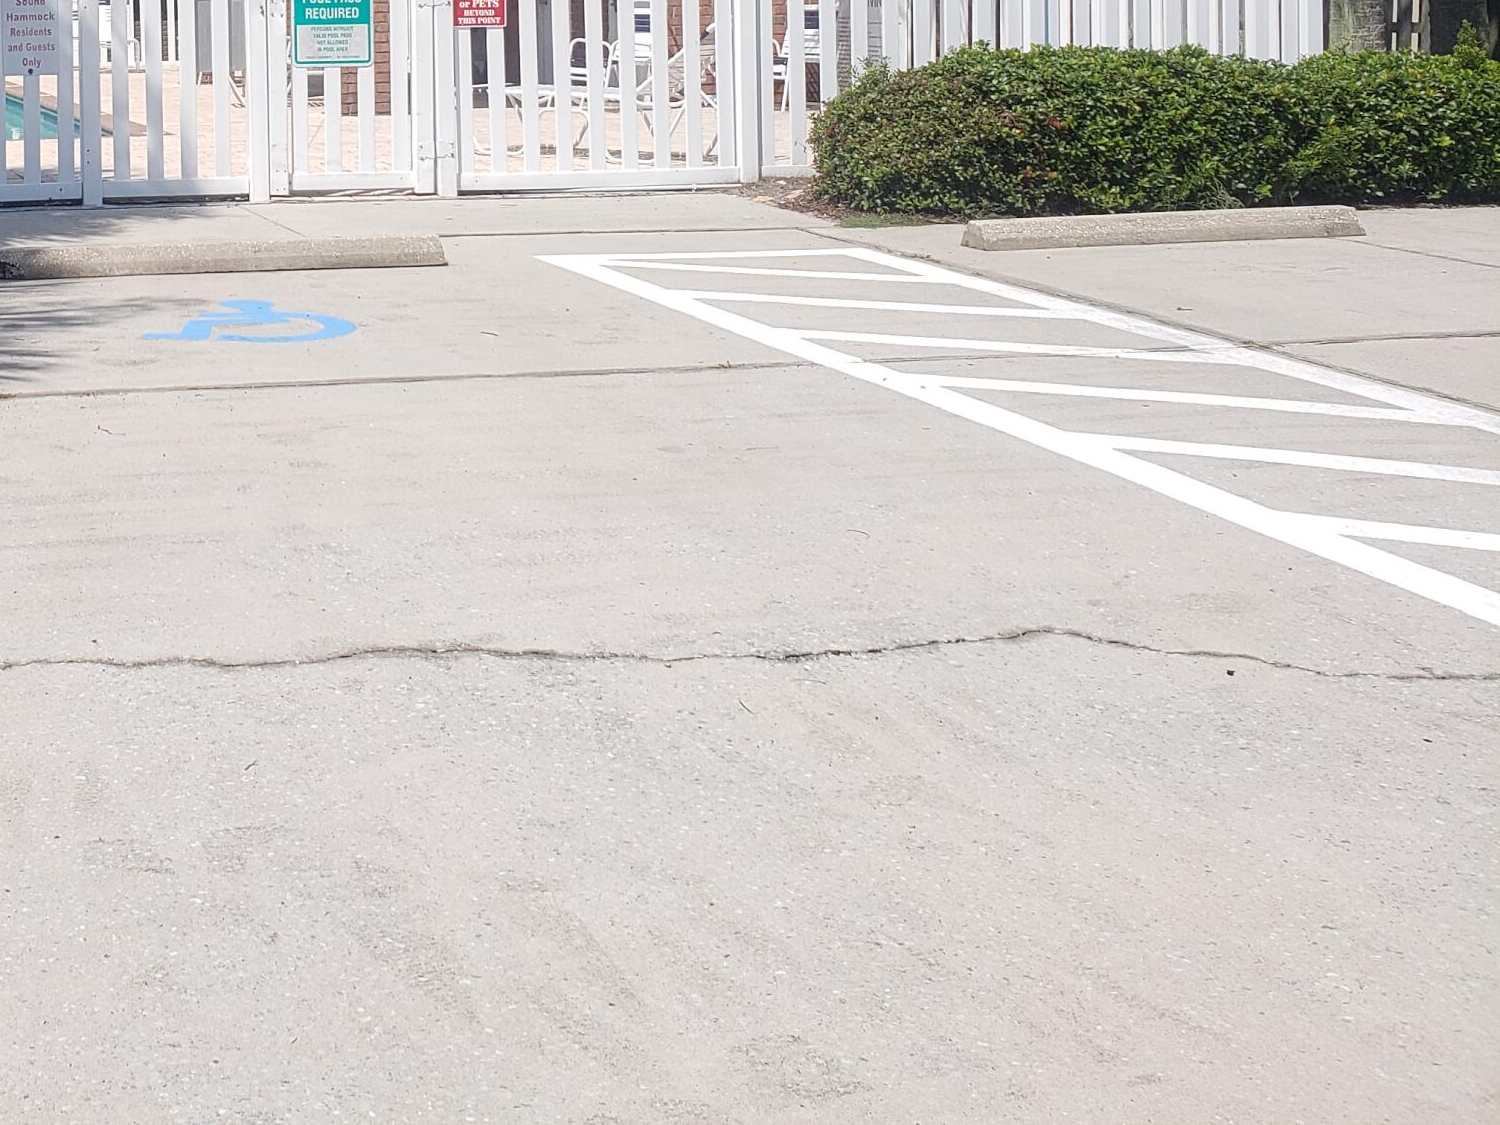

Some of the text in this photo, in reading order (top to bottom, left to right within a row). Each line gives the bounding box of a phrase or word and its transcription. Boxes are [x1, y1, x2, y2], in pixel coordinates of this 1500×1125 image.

[472, 0, 499, 8] PETS
[6, 12, 55, 21] Hammock
[305, 7, 359, 19] REQUIRED
[463, 9, 495, 17] BEYOND
[10, 27, 52, 37] Residents
[8, 42, 55, 52] and Guests
[22, 57, 41, 68] Only
